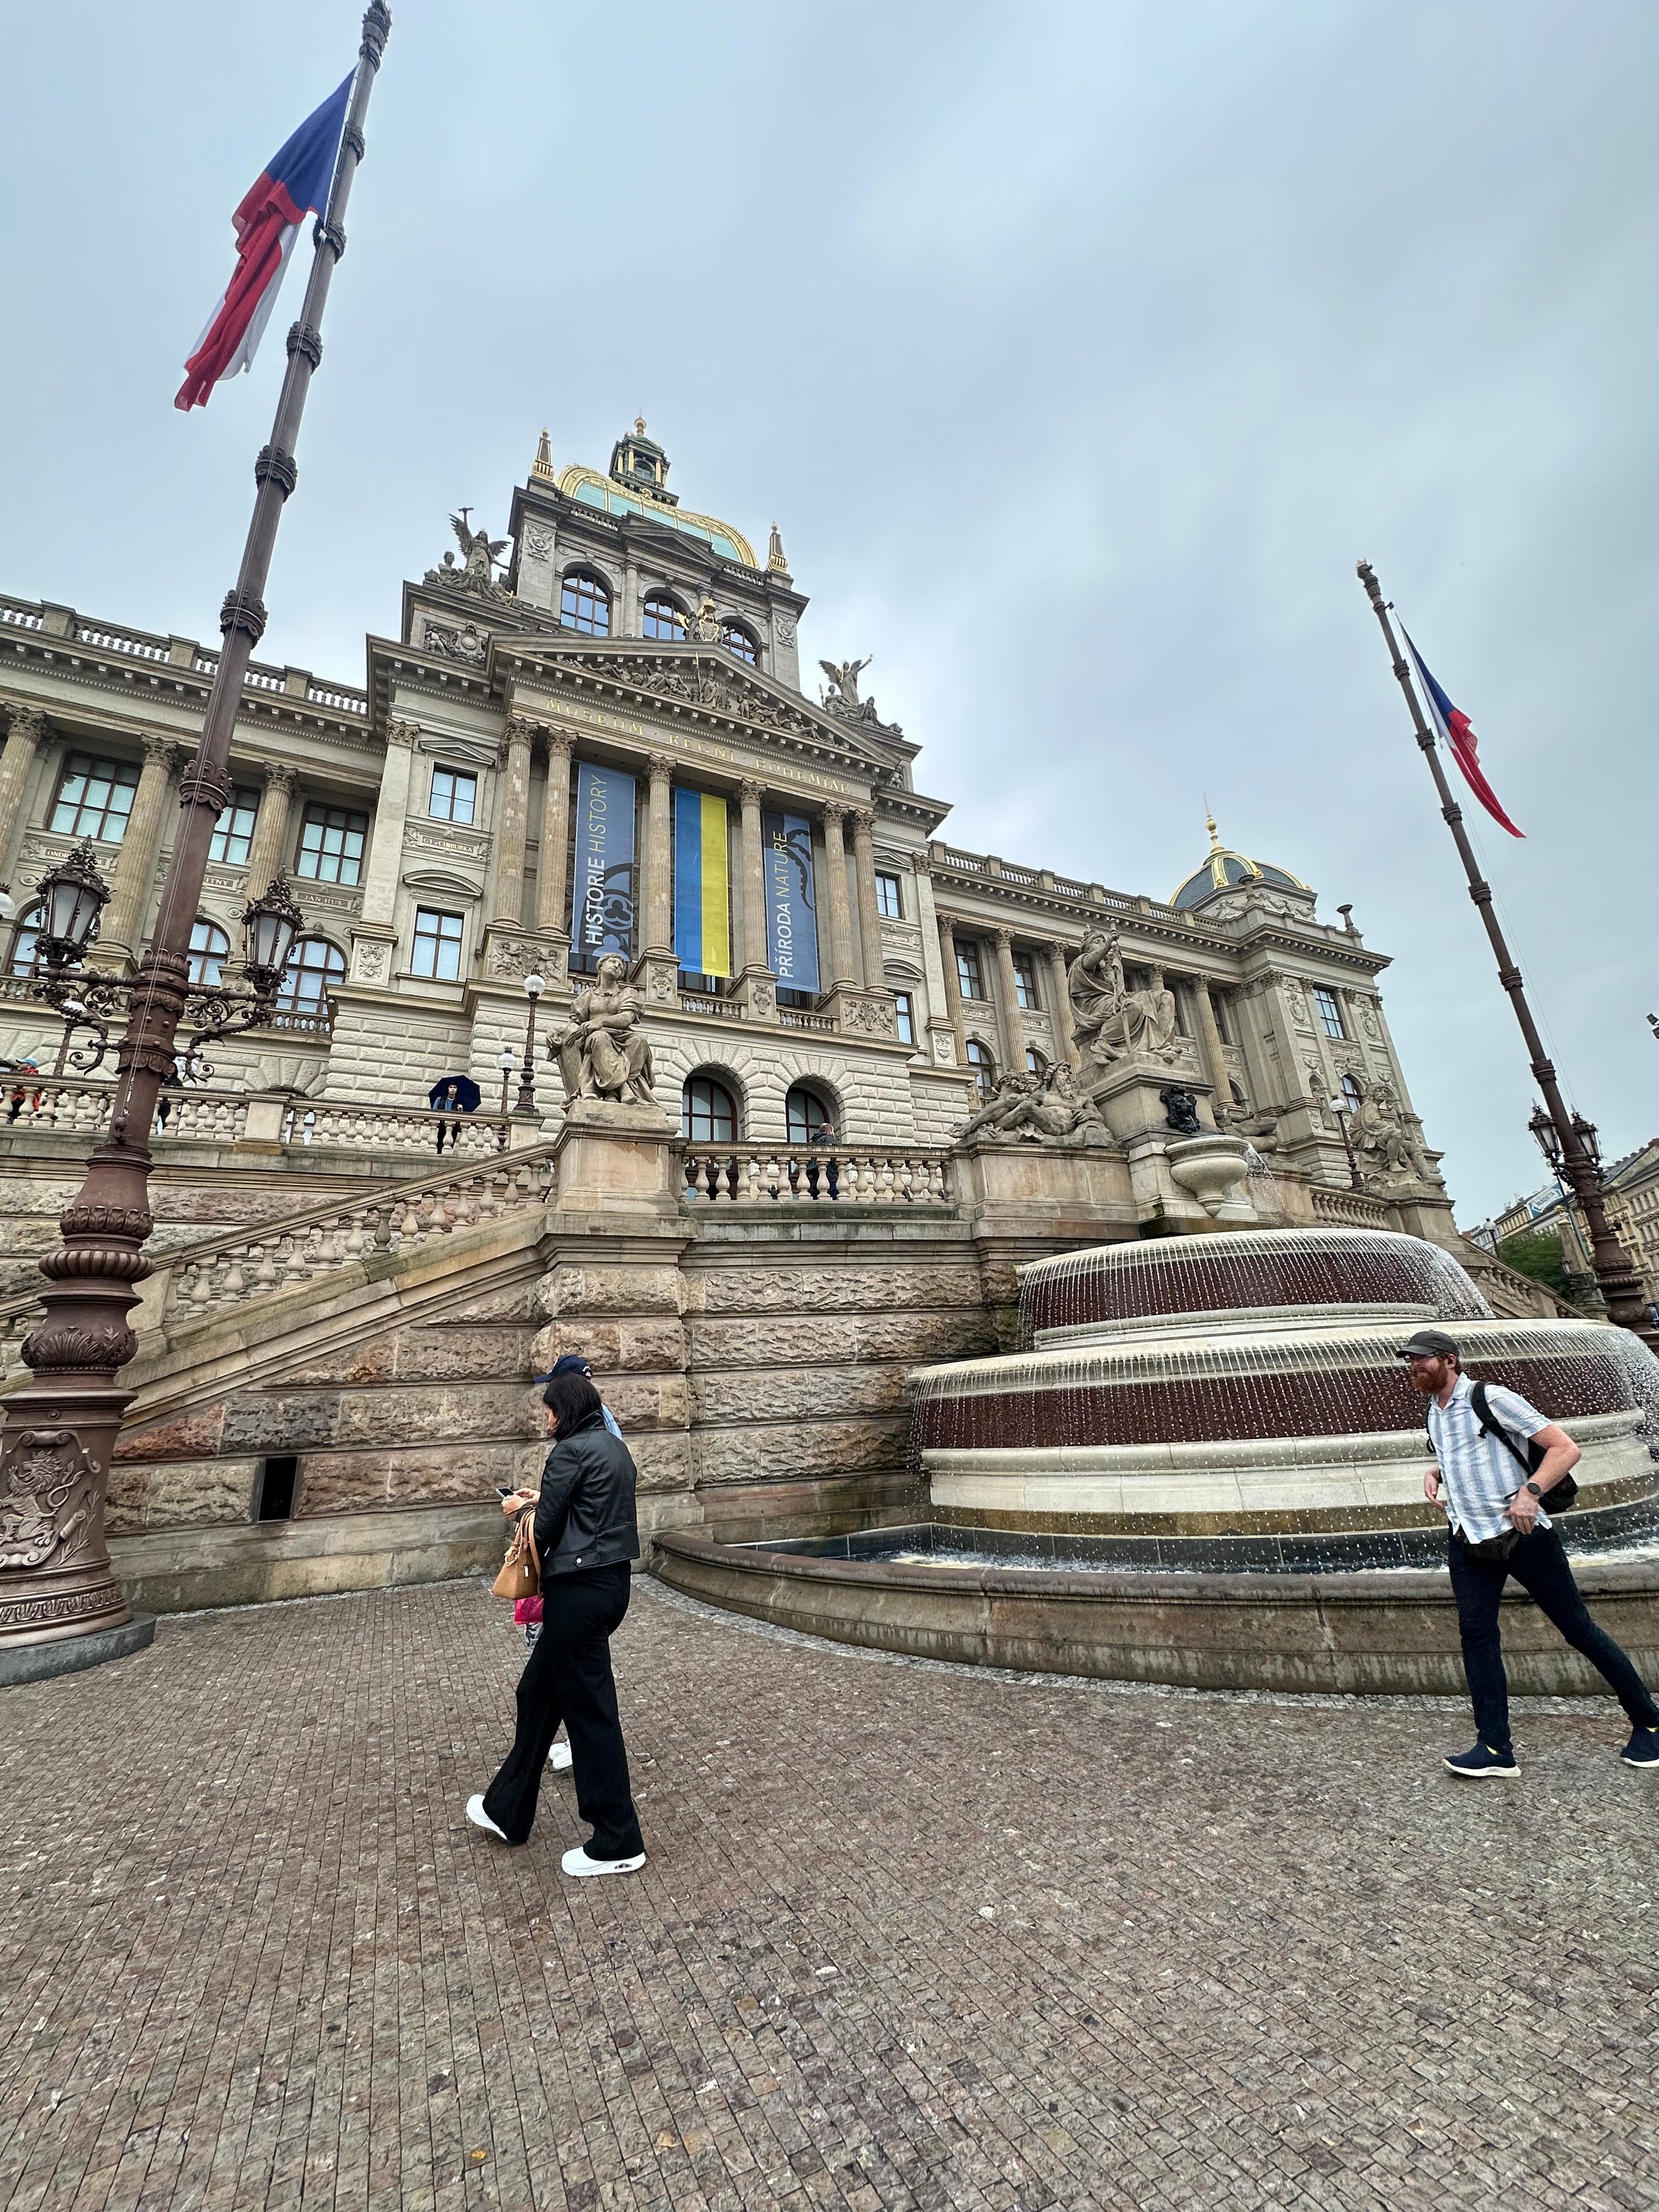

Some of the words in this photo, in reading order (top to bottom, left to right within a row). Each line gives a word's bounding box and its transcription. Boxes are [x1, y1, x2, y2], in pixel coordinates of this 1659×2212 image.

[546, 698, 644, 736] MUSEUM
[669, 733, 735, 761] REGNI
[755, 758, 851, 793] BOHEMIAE
[588, 774, 607, 853] HISTORY
[205, 877, 229, 886] ITNY
[773, 831, 791, 898] NATURE
[324, 898, 343, 906] HUS
[585, 857, 605, 945] HISTORIE
[775, 903, 794, 978] PŘÍRODA
[1534, 1192, 1556, 1207] MADETA
